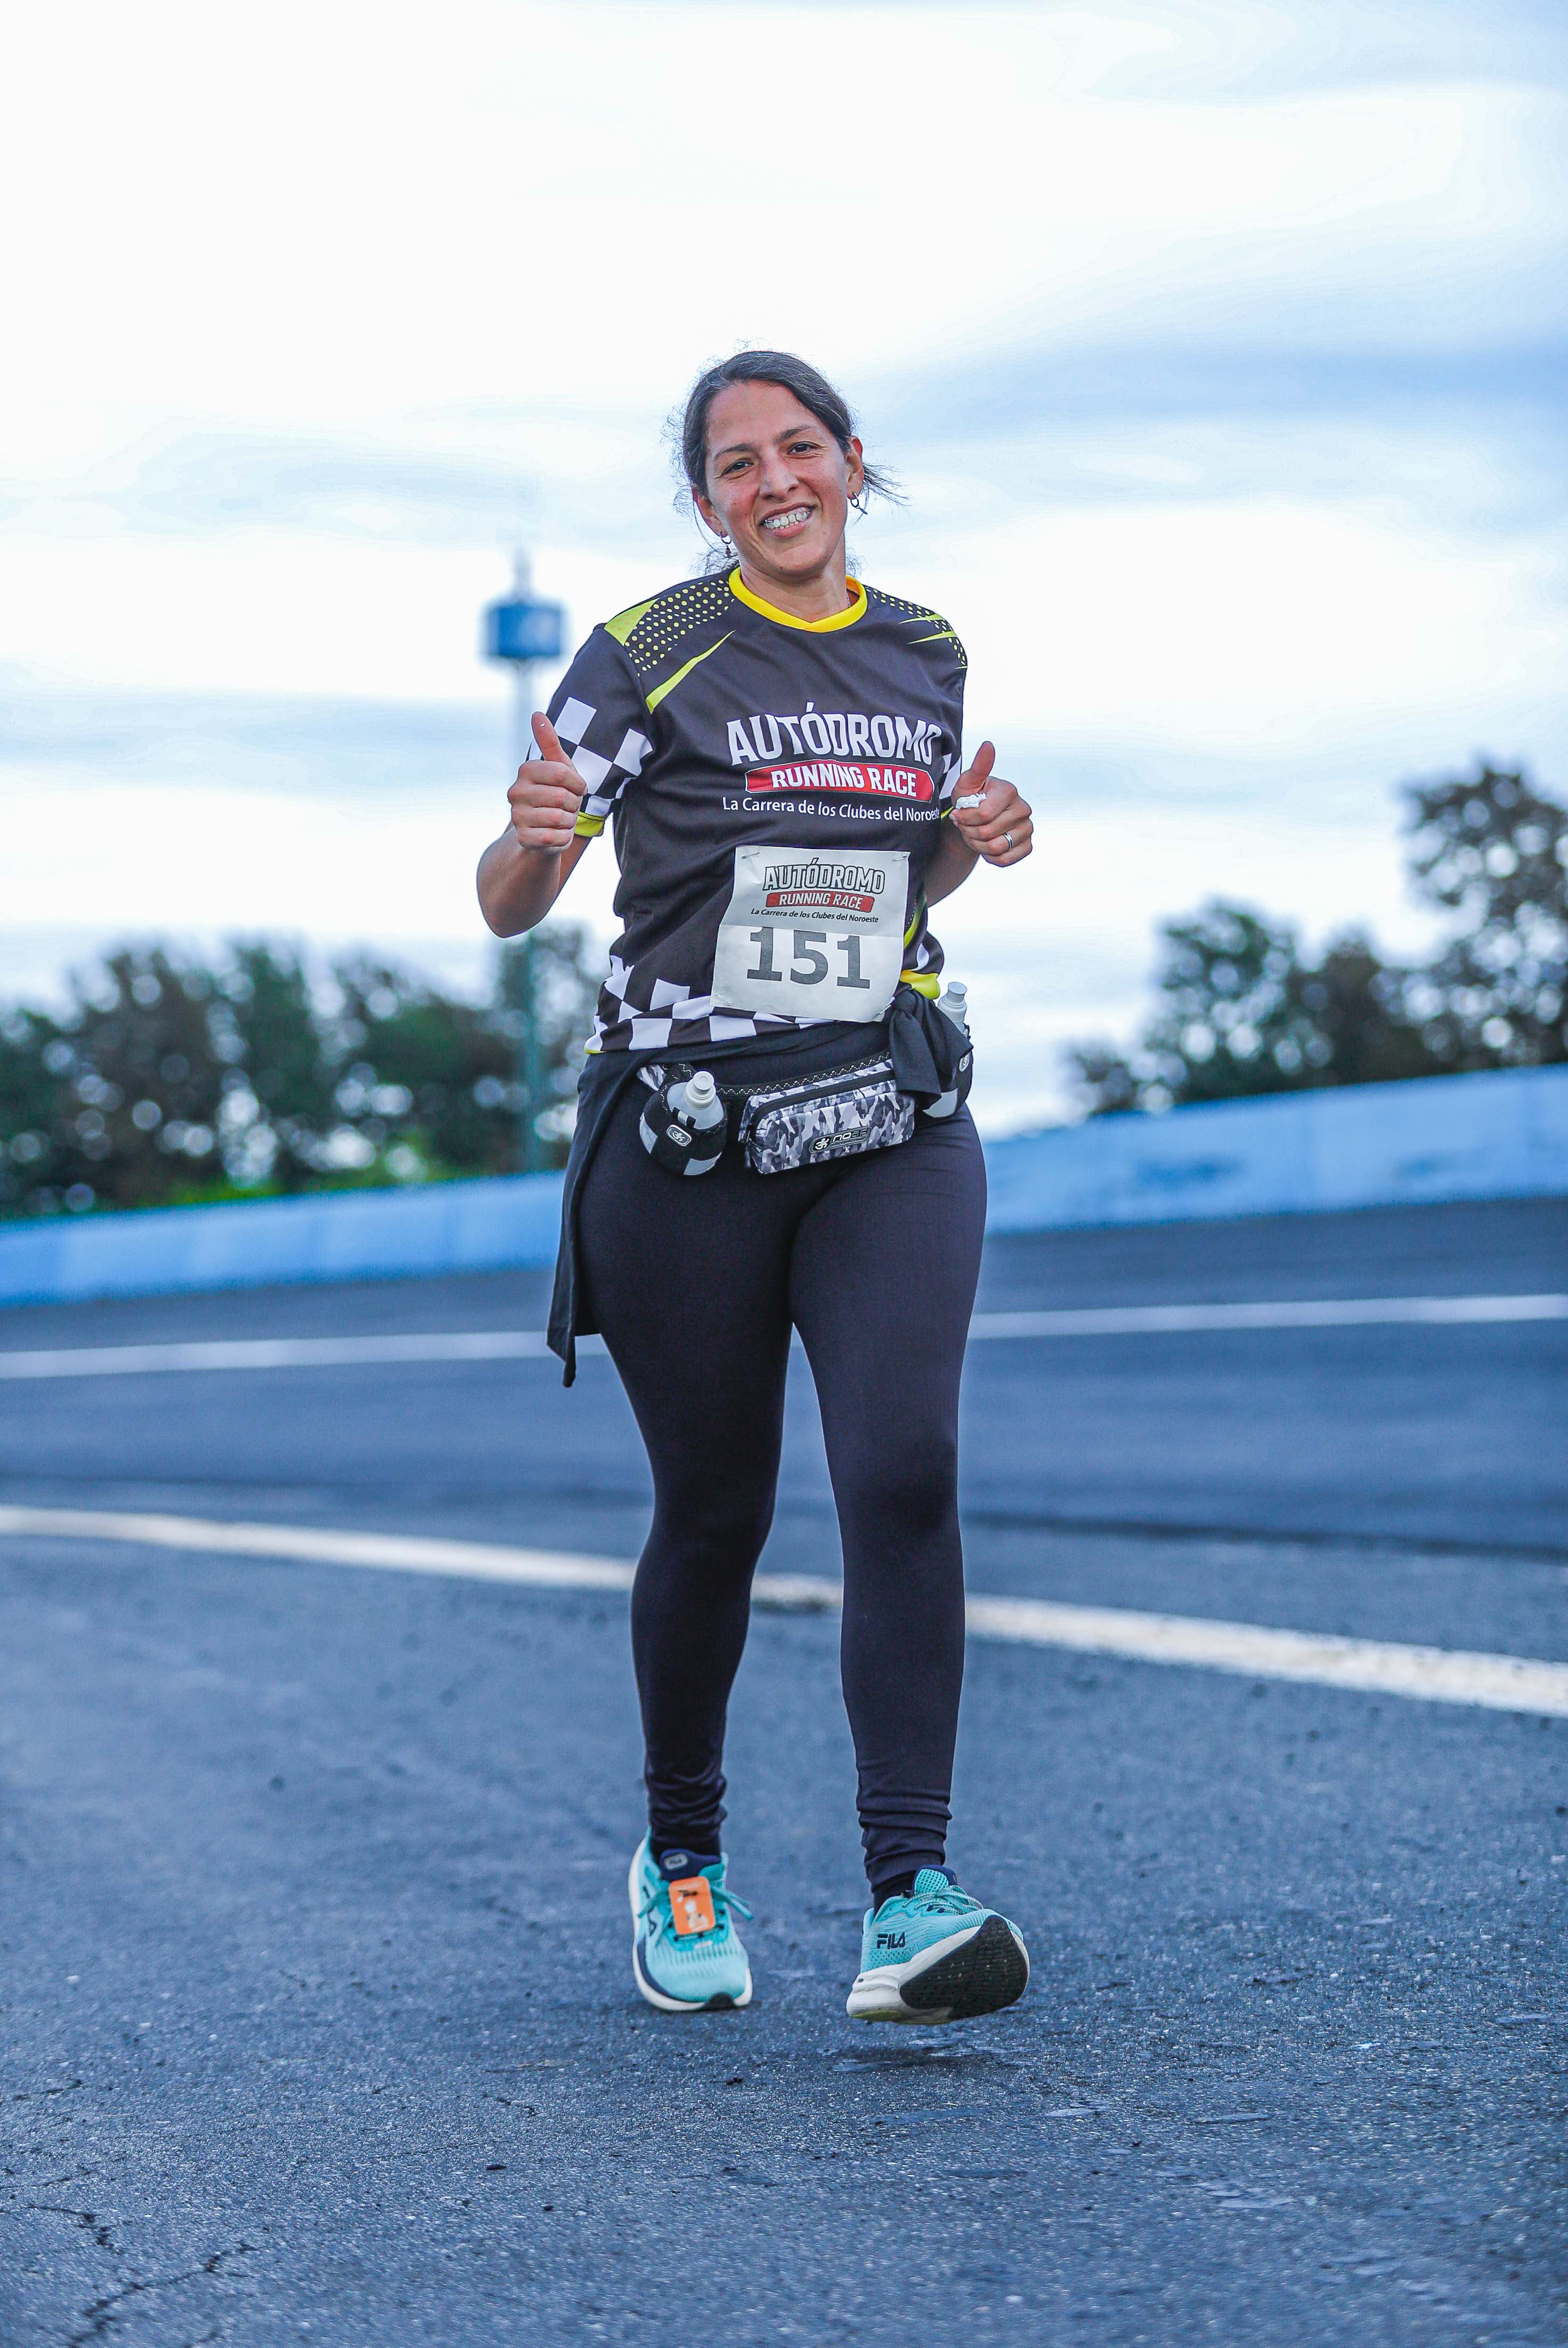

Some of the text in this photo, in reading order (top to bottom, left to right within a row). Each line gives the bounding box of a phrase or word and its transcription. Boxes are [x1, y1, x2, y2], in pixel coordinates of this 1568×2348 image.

[726, 702, 943, 766] AUTÓDROMO
[771, 763, 917, 798] RUNNING RACE
[722, 797, 738, 810] La
[742, 797, 794, 812] Carrera
[798, 800, 815, 815] de
[818, 801, 836, 817] los
[839, 804, 881, 819] Clubes
[883, 807, 903, 821] del
[762, 857, 885, 895] AUTÓDROMO
[779, 892, 863, 909] RUNNING RACE
[849, 914, 879, 923] Noroeste
[746, 926, 871, 989] 151
[876, 1931, 906, 1950] FILA
